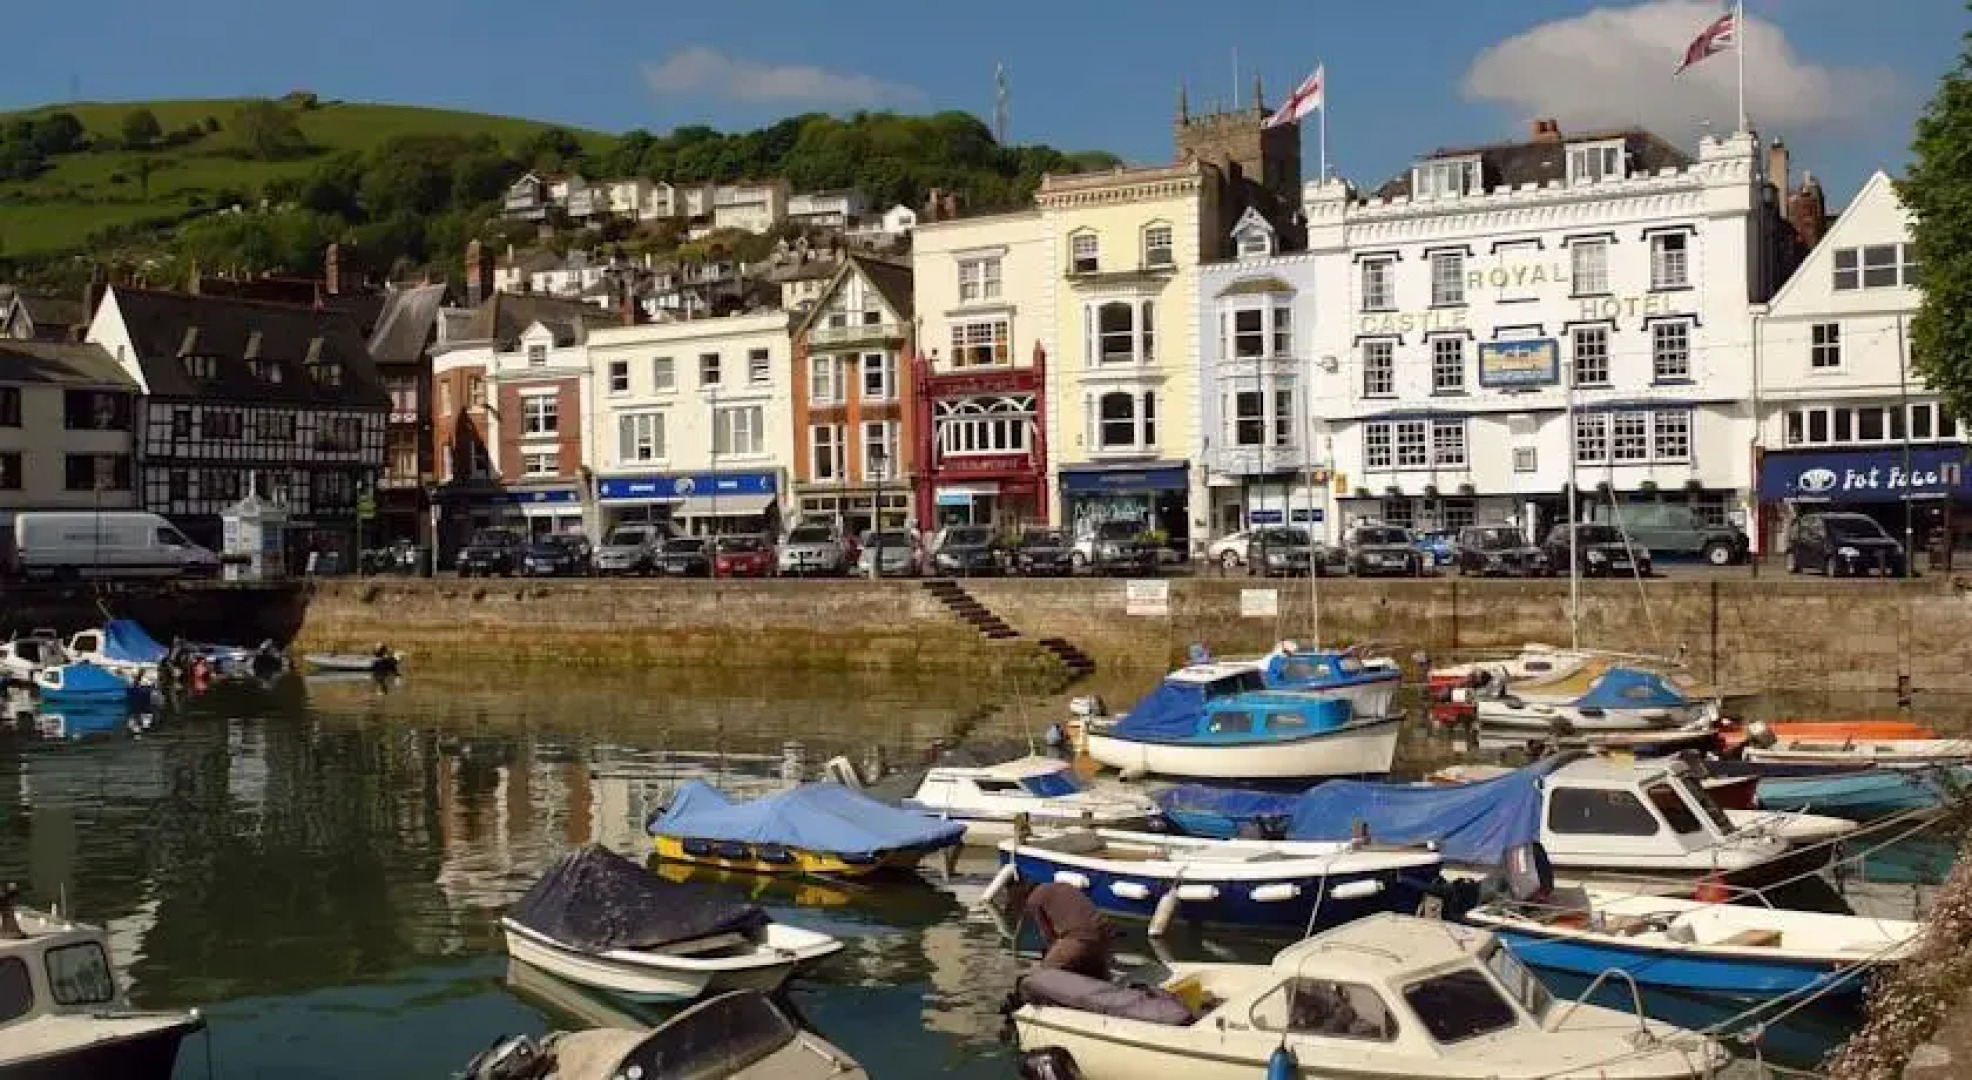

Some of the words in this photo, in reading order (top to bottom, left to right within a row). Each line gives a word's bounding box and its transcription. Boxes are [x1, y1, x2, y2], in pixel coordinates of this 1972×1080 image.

[1467, 263, 1569, 290] ROYAL
[1361, 310, 1467, 334] CASTLE
[1580, 294, 1681, 320] HOTEL
